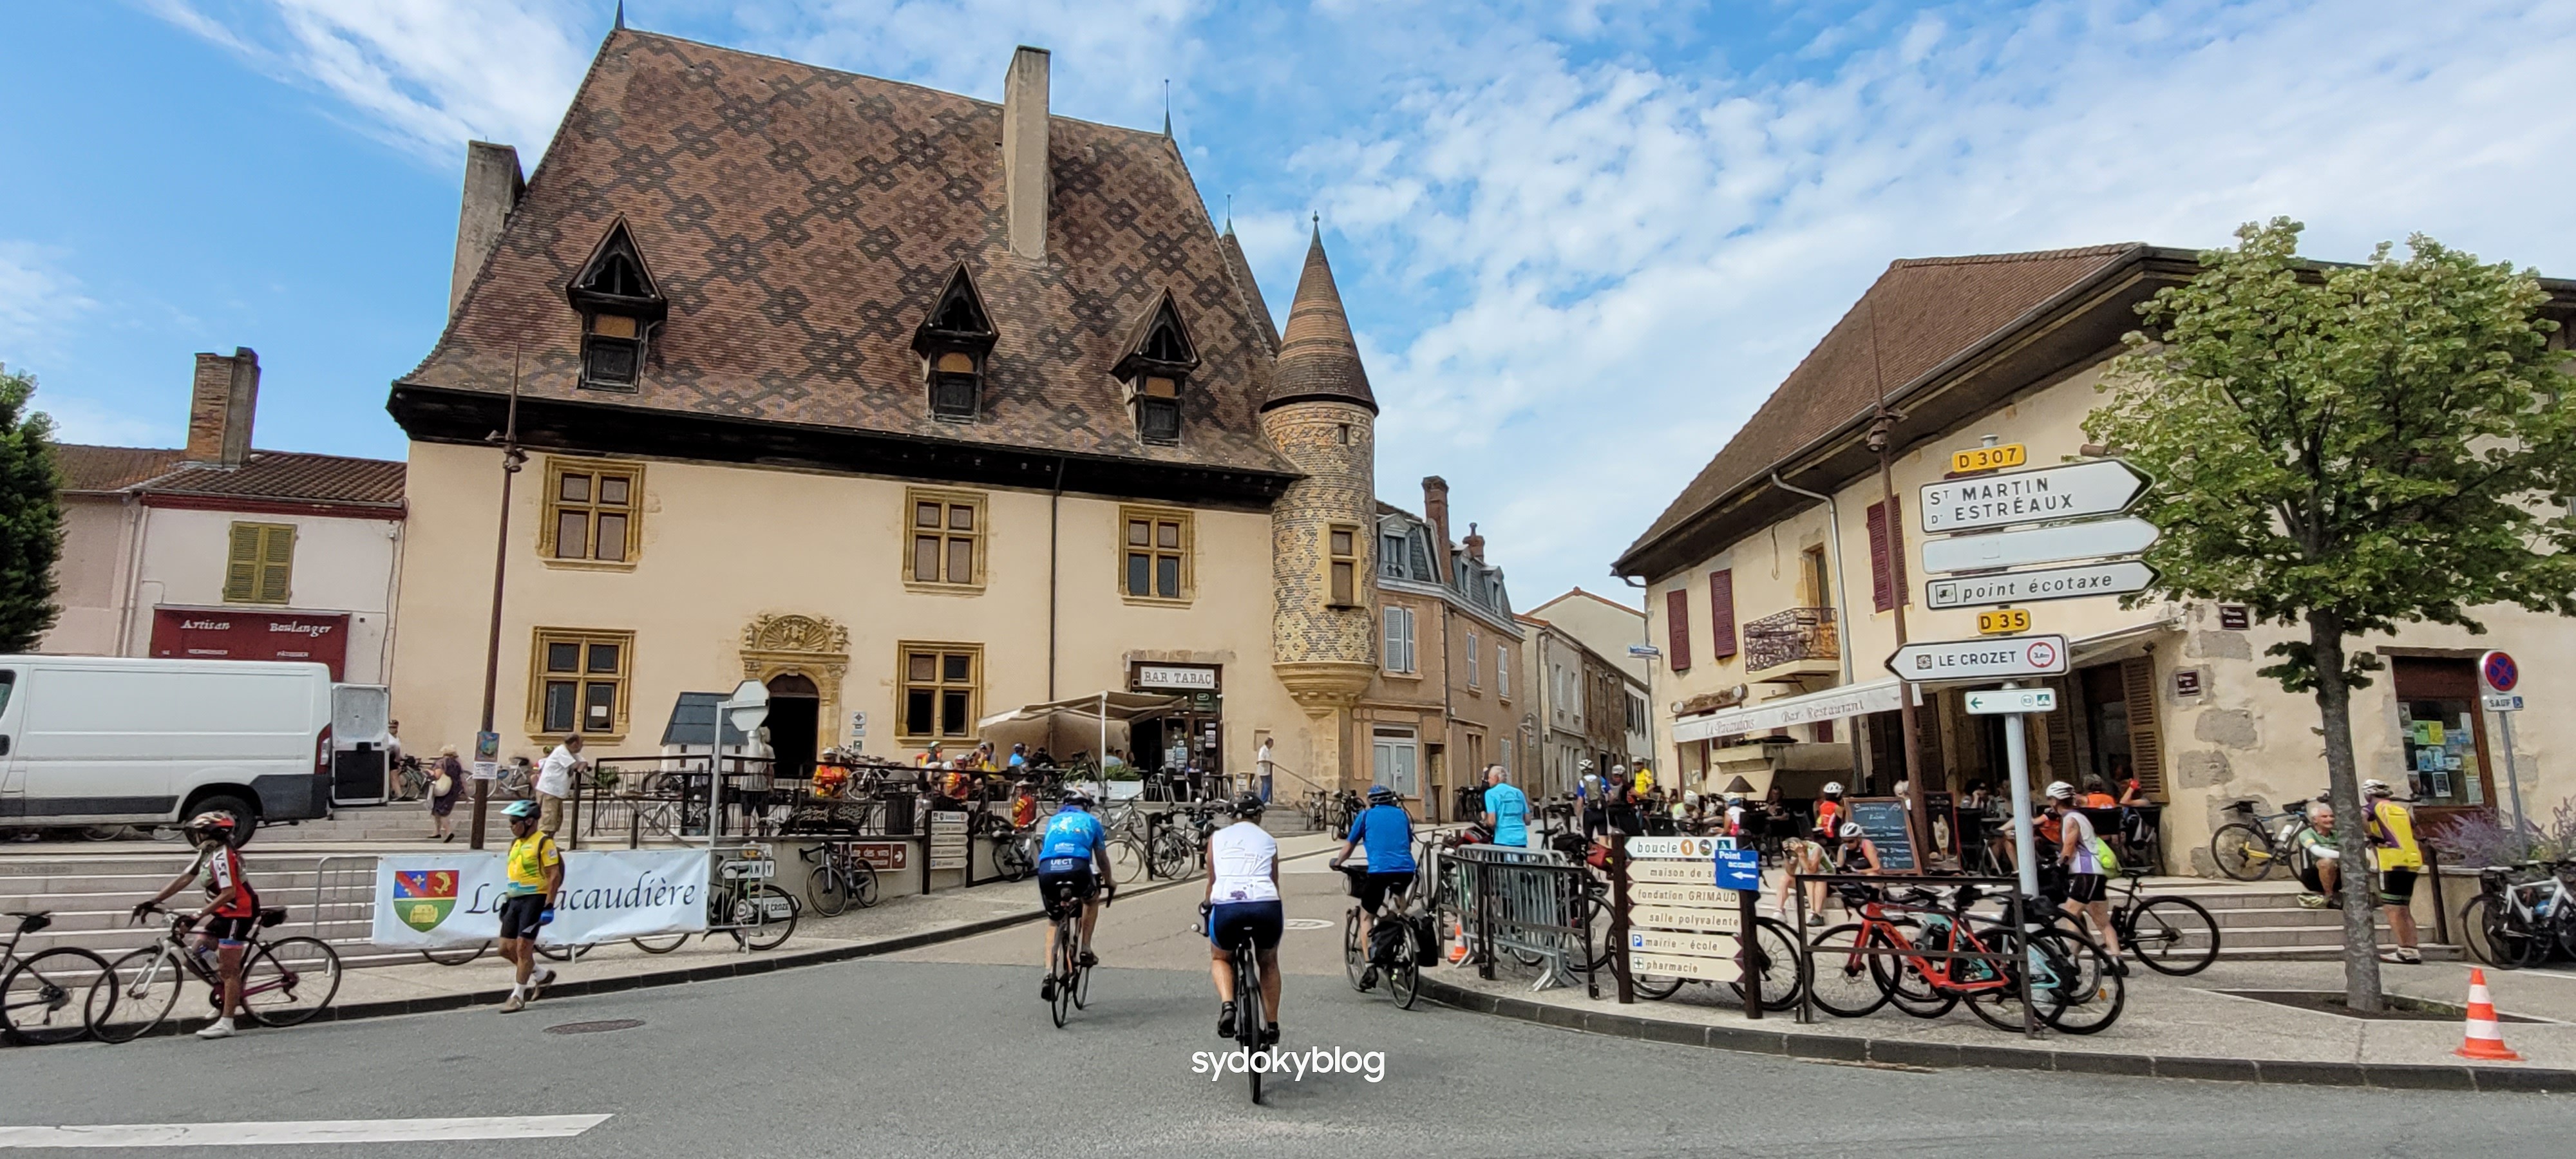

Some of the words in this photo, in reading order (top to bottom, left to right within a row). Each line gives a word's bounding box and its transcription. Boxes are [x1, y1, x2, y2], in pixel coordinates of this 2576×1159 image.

[1959, 455, 1970, 469] D
[1978, 448, 2017, 466] 307
[1962, 477, 2049, 502] MARTIN
[1955, 493, 2074, 522] ESTRÉAUX
[1963, 582, 2016, 602] point
[2029, 575, 2112, 594] écotaxe
[180, 619, 231, 630] Artisan
[269, 621, 332, 637] Boulanger
[1980, 616, 1991, 630] D
[1999, 612, 2025, 628] 35
[1938, 655, 1955, 666] LE
[1960, 651, 2017, 665] CROZET
[1144, 671, 1169, 683] BAR
[1174, 672, 1211, 684] TABAC
[1807, 699, 1864, 719] Restaurant
[2489, 699, 2510, 707] SAUF
[1637, 841, 1678, 853] boucle
[1684, 841, 1690, 854] 1
[1719, 851, 1741, 860] Point
[1650, 868, 1685, 877] maison
[1690, 868, 1702, 878] de
[554, 870, 696, 911] acaudière
[1638, 889, 1683, 900] fondation
[1689, 890, 1737, 902] GRIMAUD
[1649, 912, 1673, 923] salle
[1678, 914, 1739, 927] polyvalente
[1645, 938, 1676, 948] mairie
[1690, 939, 1718, 951] école
[1646, 960, 1698, 973] pharmacie
